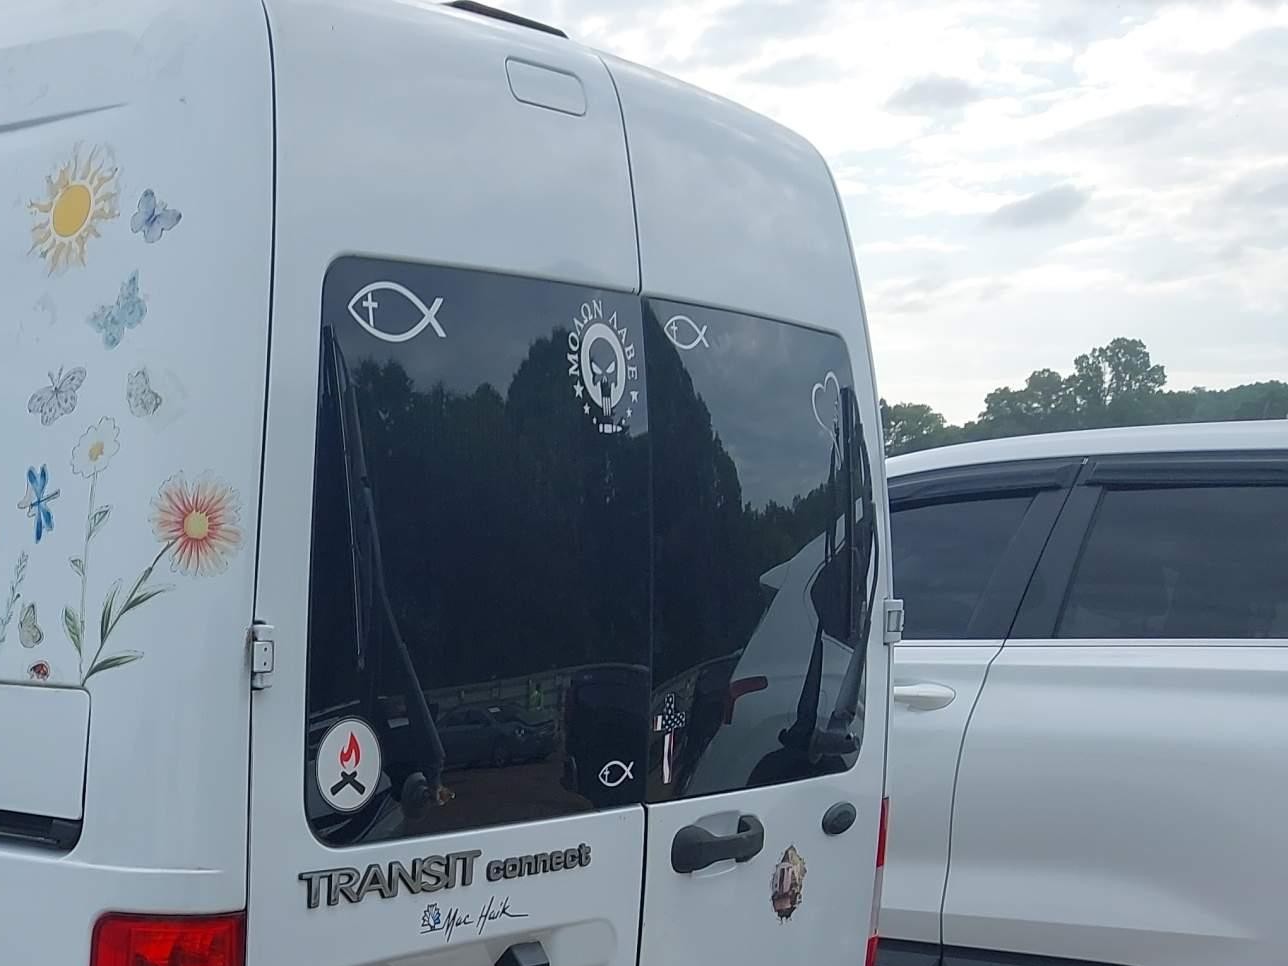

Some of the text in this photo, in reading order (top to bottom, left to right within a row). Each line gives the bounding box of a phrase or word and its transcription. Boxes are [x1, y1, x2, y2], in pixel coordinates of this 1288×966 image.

[298, 842, 592, 909] TRANSIT connect
[443, 896, 529, 942] Mac Haik
